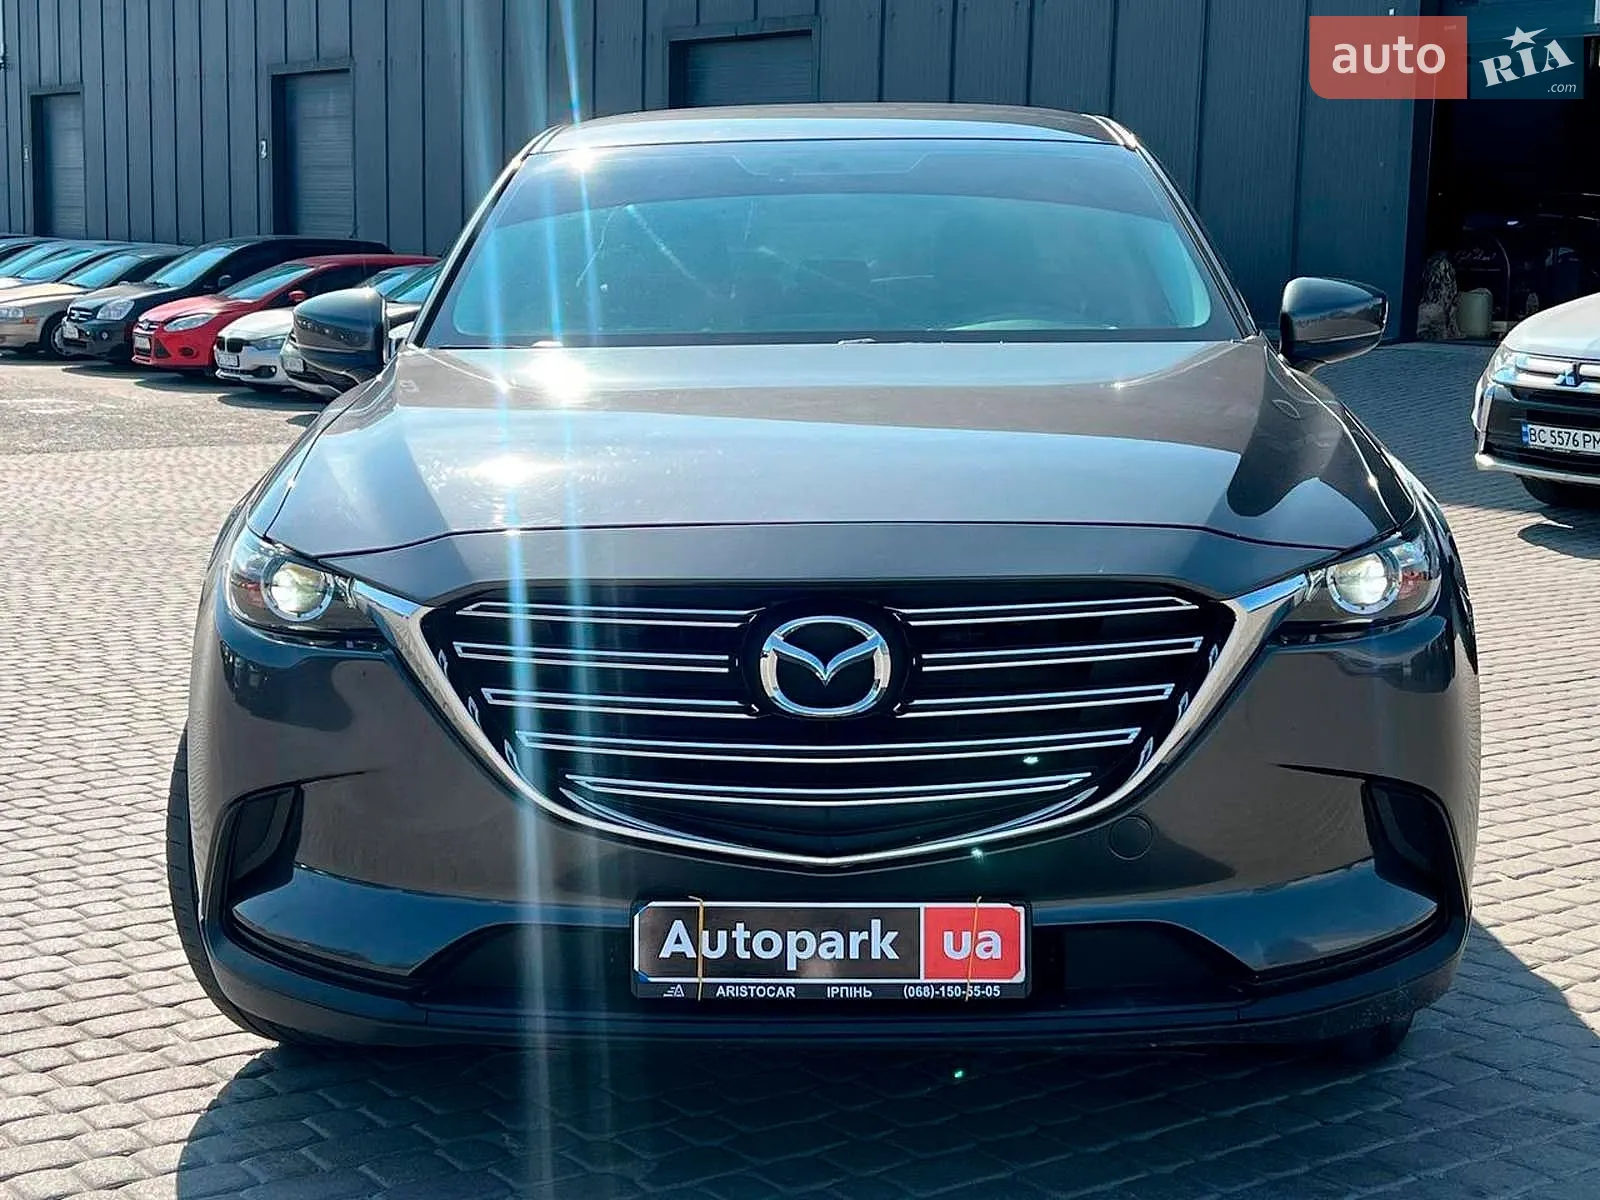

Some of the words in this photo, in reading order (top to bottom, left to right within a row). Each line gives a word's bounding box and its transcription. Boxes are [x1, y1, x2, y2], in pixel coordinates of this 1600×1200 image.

[1529, 428, 1546, 443] BC
[1550, 430, 1579, 447] 5576
[658, 919, 900, 971] Autopark
[943, 930, 1002, 961] ua
[716, 985, 796, 998] ARISTOCAR
[826, 986, 873, 998] ІРПІНЬ
[903, 984, 1001, 999] (068)-150-55-05
